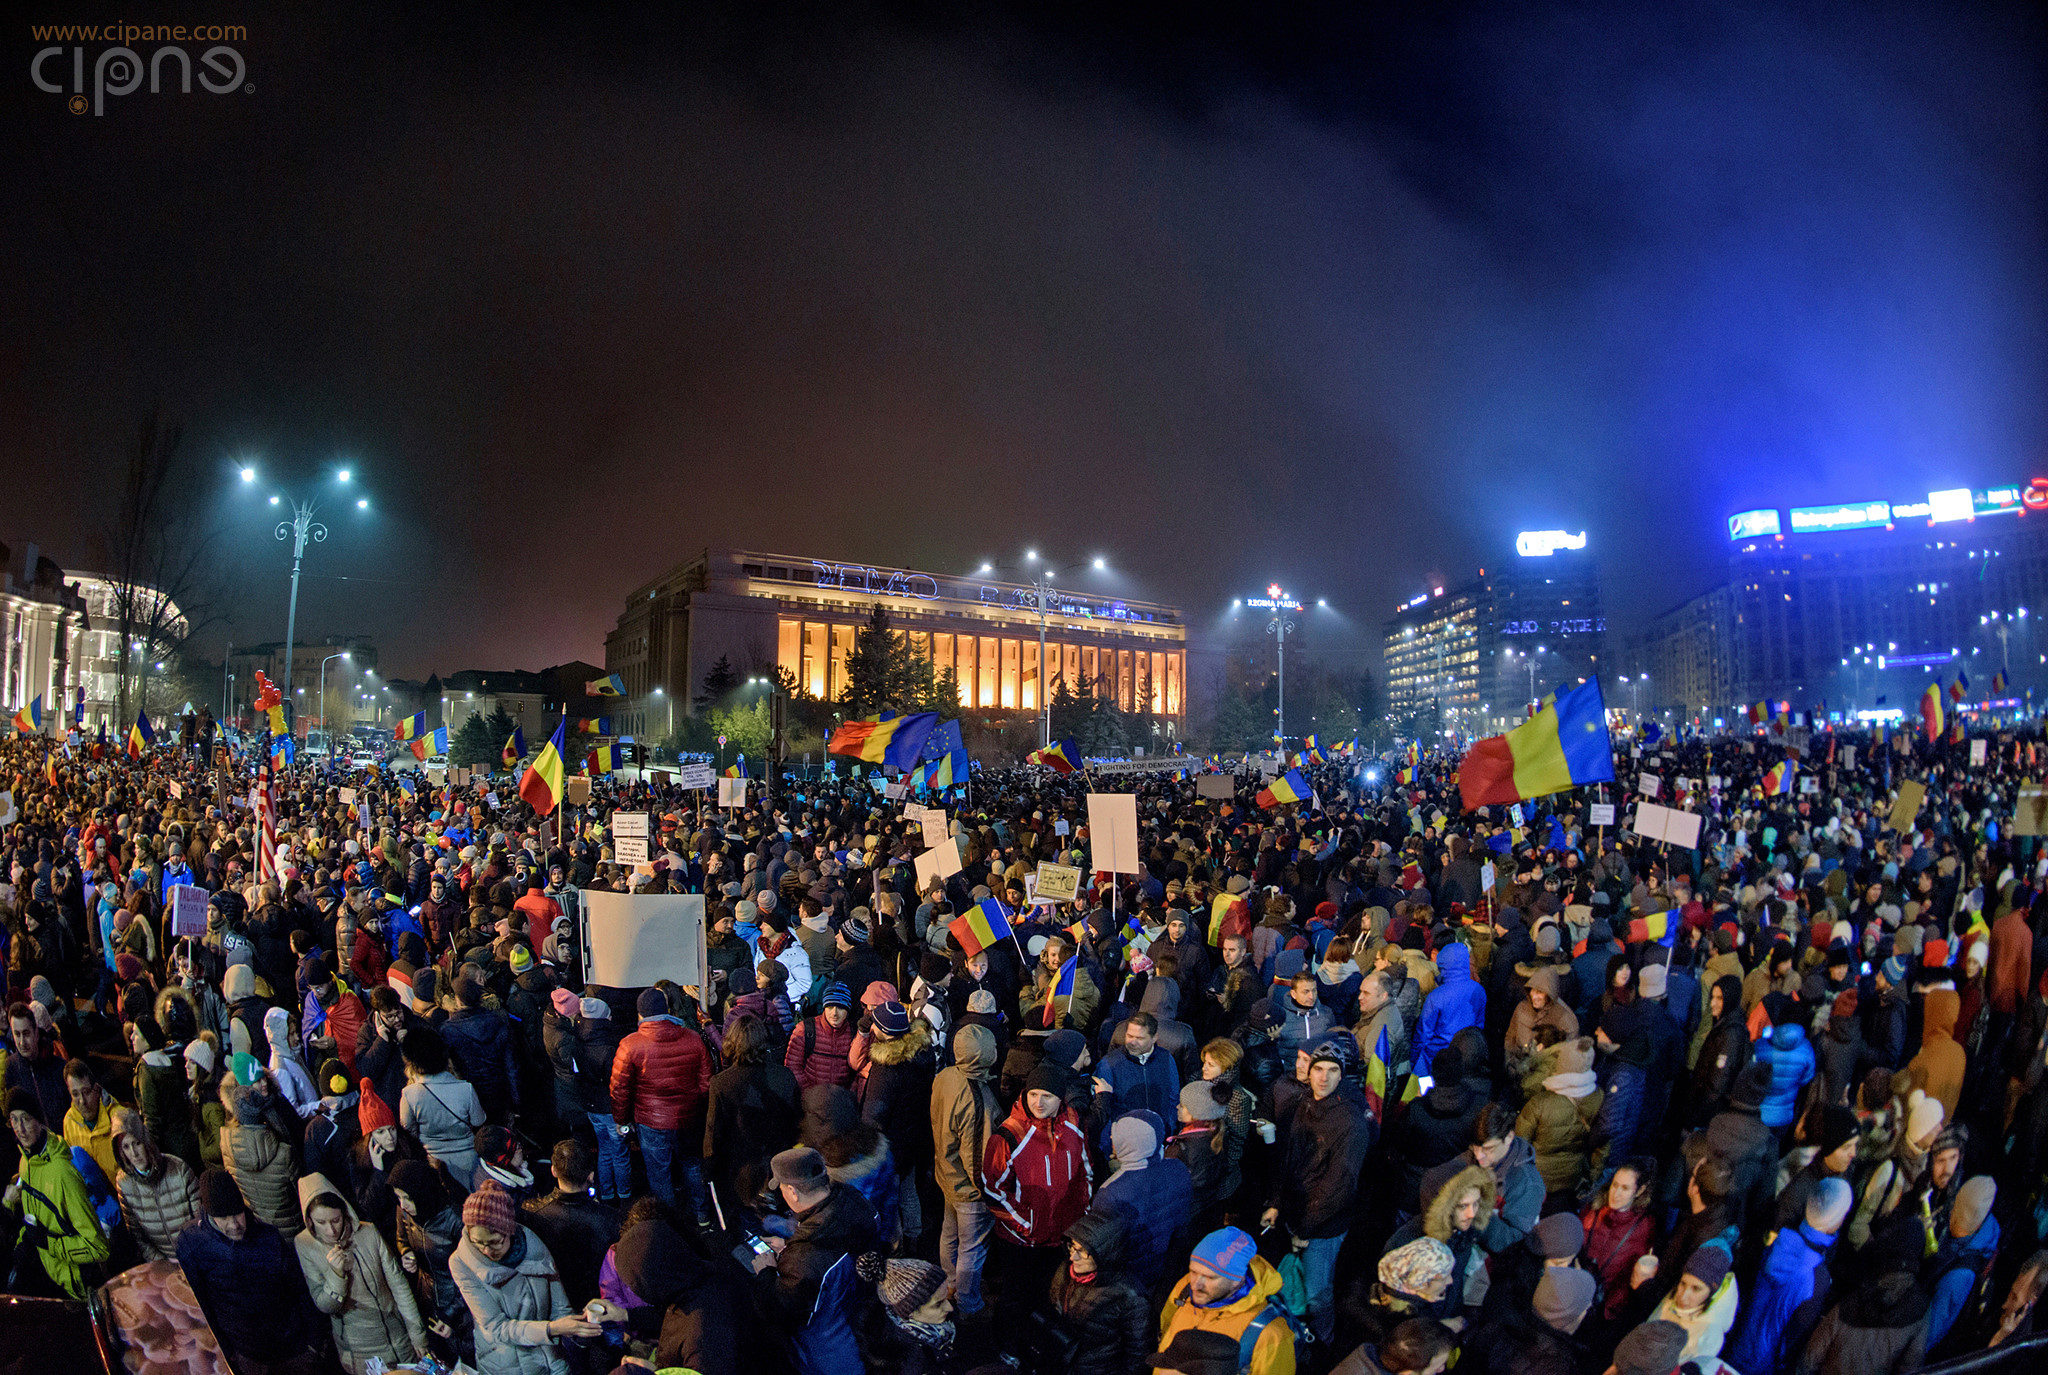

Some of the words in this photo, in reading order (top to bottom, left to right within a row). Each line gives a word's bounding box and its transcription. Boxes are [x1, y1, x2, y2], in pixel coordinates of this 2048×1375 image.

[1247, 598, 1276, 607] REGINA
[1276, 599, 1301, 609] MARIA
[1100, 763, 1131, 772] FIGHTING
